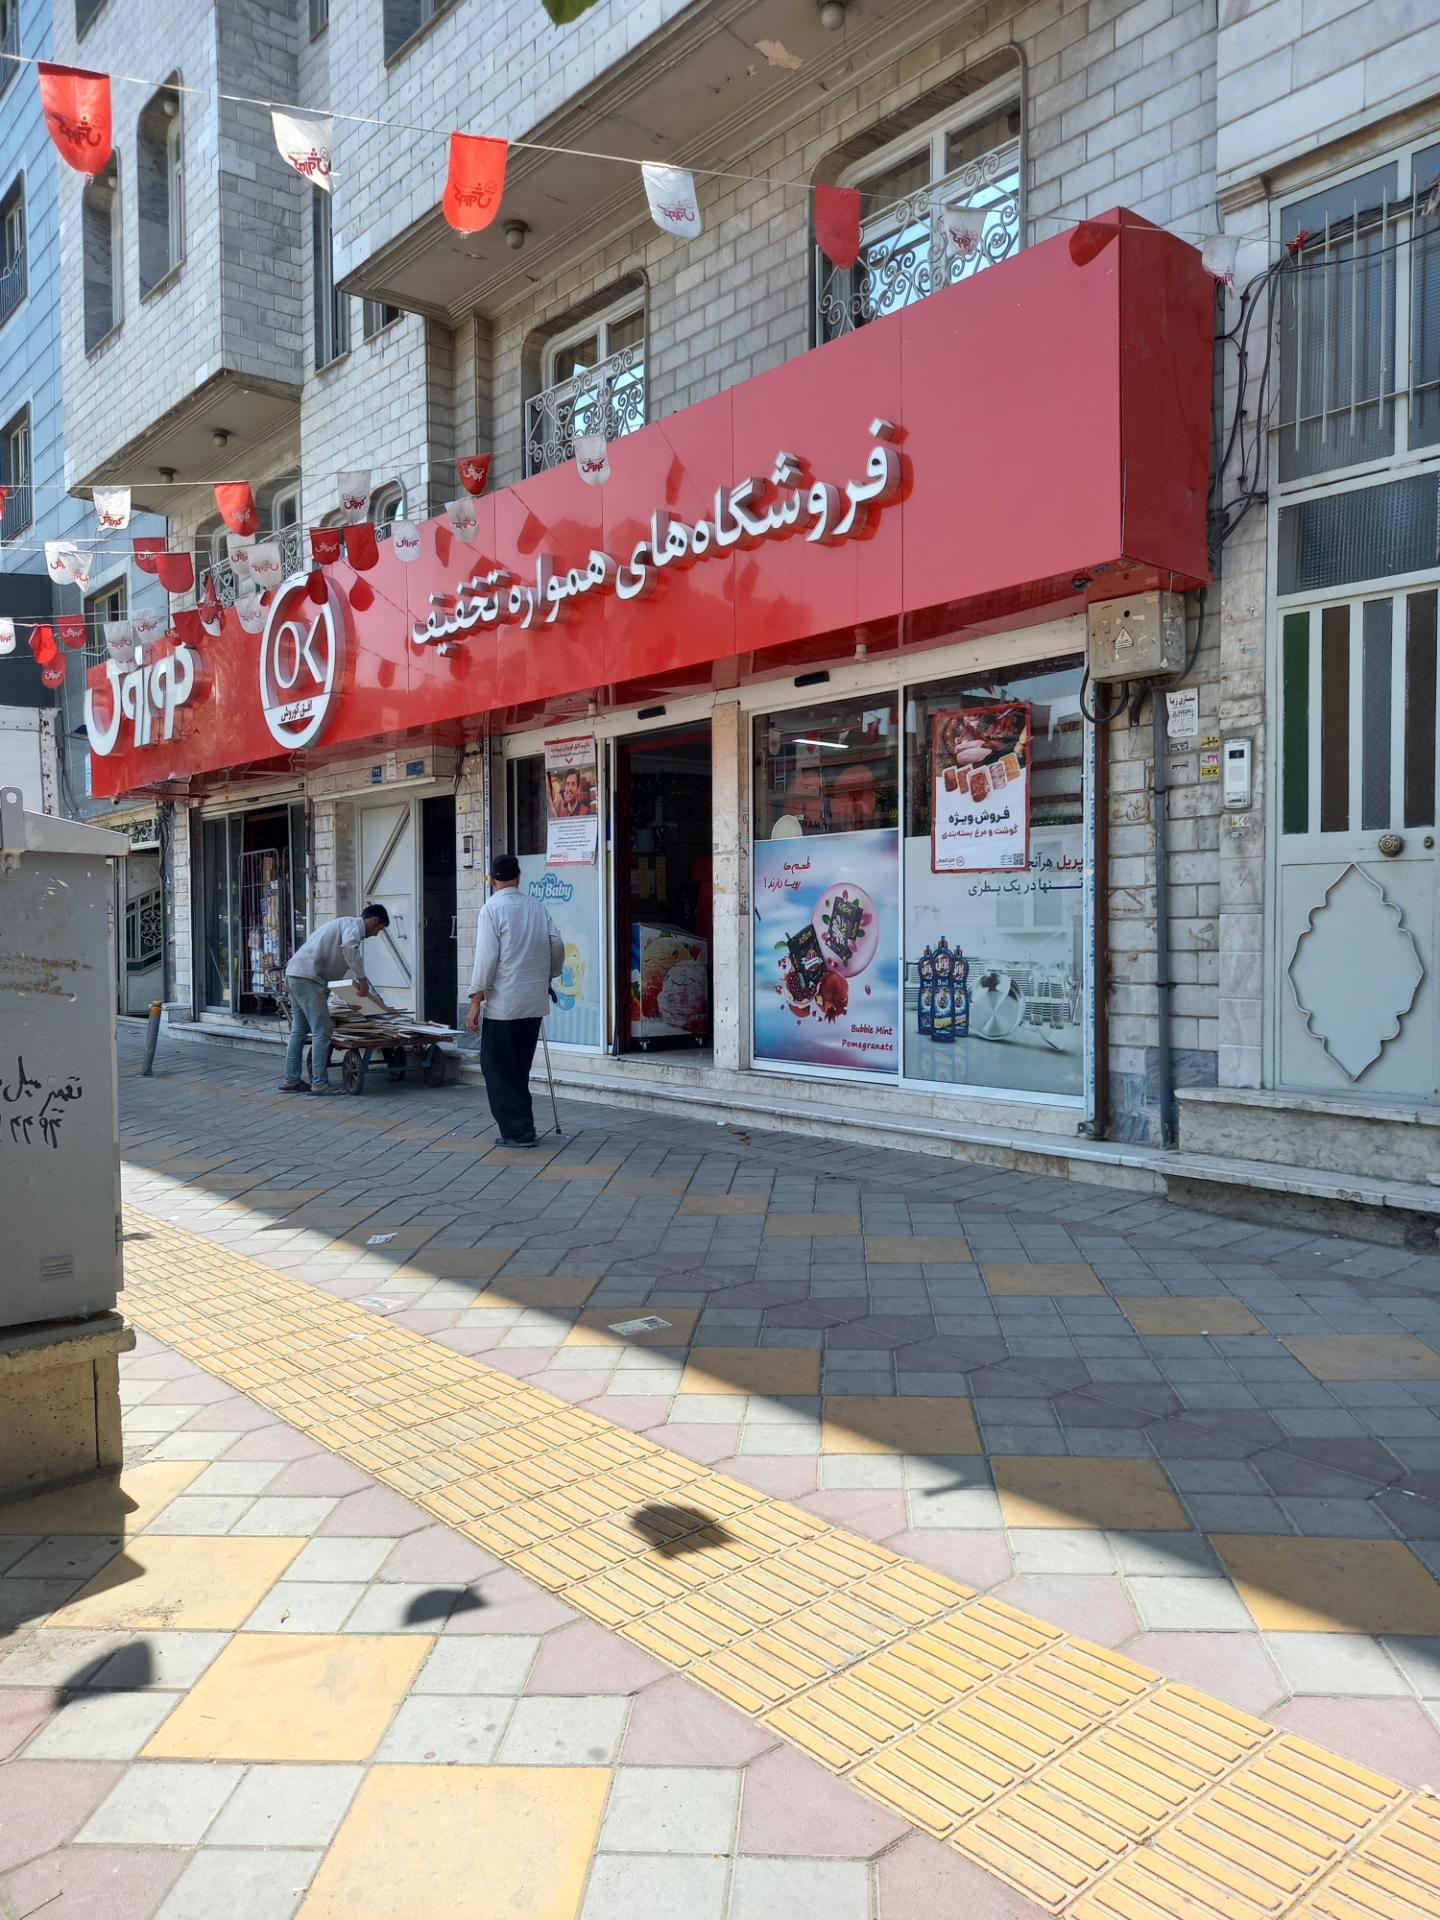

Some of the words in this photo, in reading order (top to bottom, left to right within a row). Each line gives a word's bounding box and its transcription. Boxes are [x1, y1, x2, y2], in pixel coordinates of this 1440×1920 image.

[344, 496, 367, 510] کوروش
[616, 416, 901, 599] فروشگاه‌های
[99, 511, 125, 528] کوروش
[509, 550, 614, 630] همواره
[412, 569, 511, 657] تخفیف
[273, 613, 324, 690] OK
[281, 703, 300, 722] کوروش
[301, 700, 313, 717] افق
[948, 811, 974, 826] ویژه
[975, 805, 1010, 825] فروش
[974, 828, 988, 839] مرغ
[994, 824, 1018, 837] گوشت
[1057, 855, 1084, 872] پریل
[529, 882, 545, 902] My
[545, 881, 572, 902] Baby
[968, 880, 1001, 897] بطری
[1004, 879, 1021, 895] یک
[1025, 881, 1036, 894] در
[1039, 877, 1084, 894] تنها
[851, 1023, 874, 1034] Bubble
[875, 1025, 894, 1036] Mint
[842, 1038, 894, 1052] Pomegranate
[3, 1055, 42, 1103] مبل
[39, 1076, 83, 1117] تعمیر
